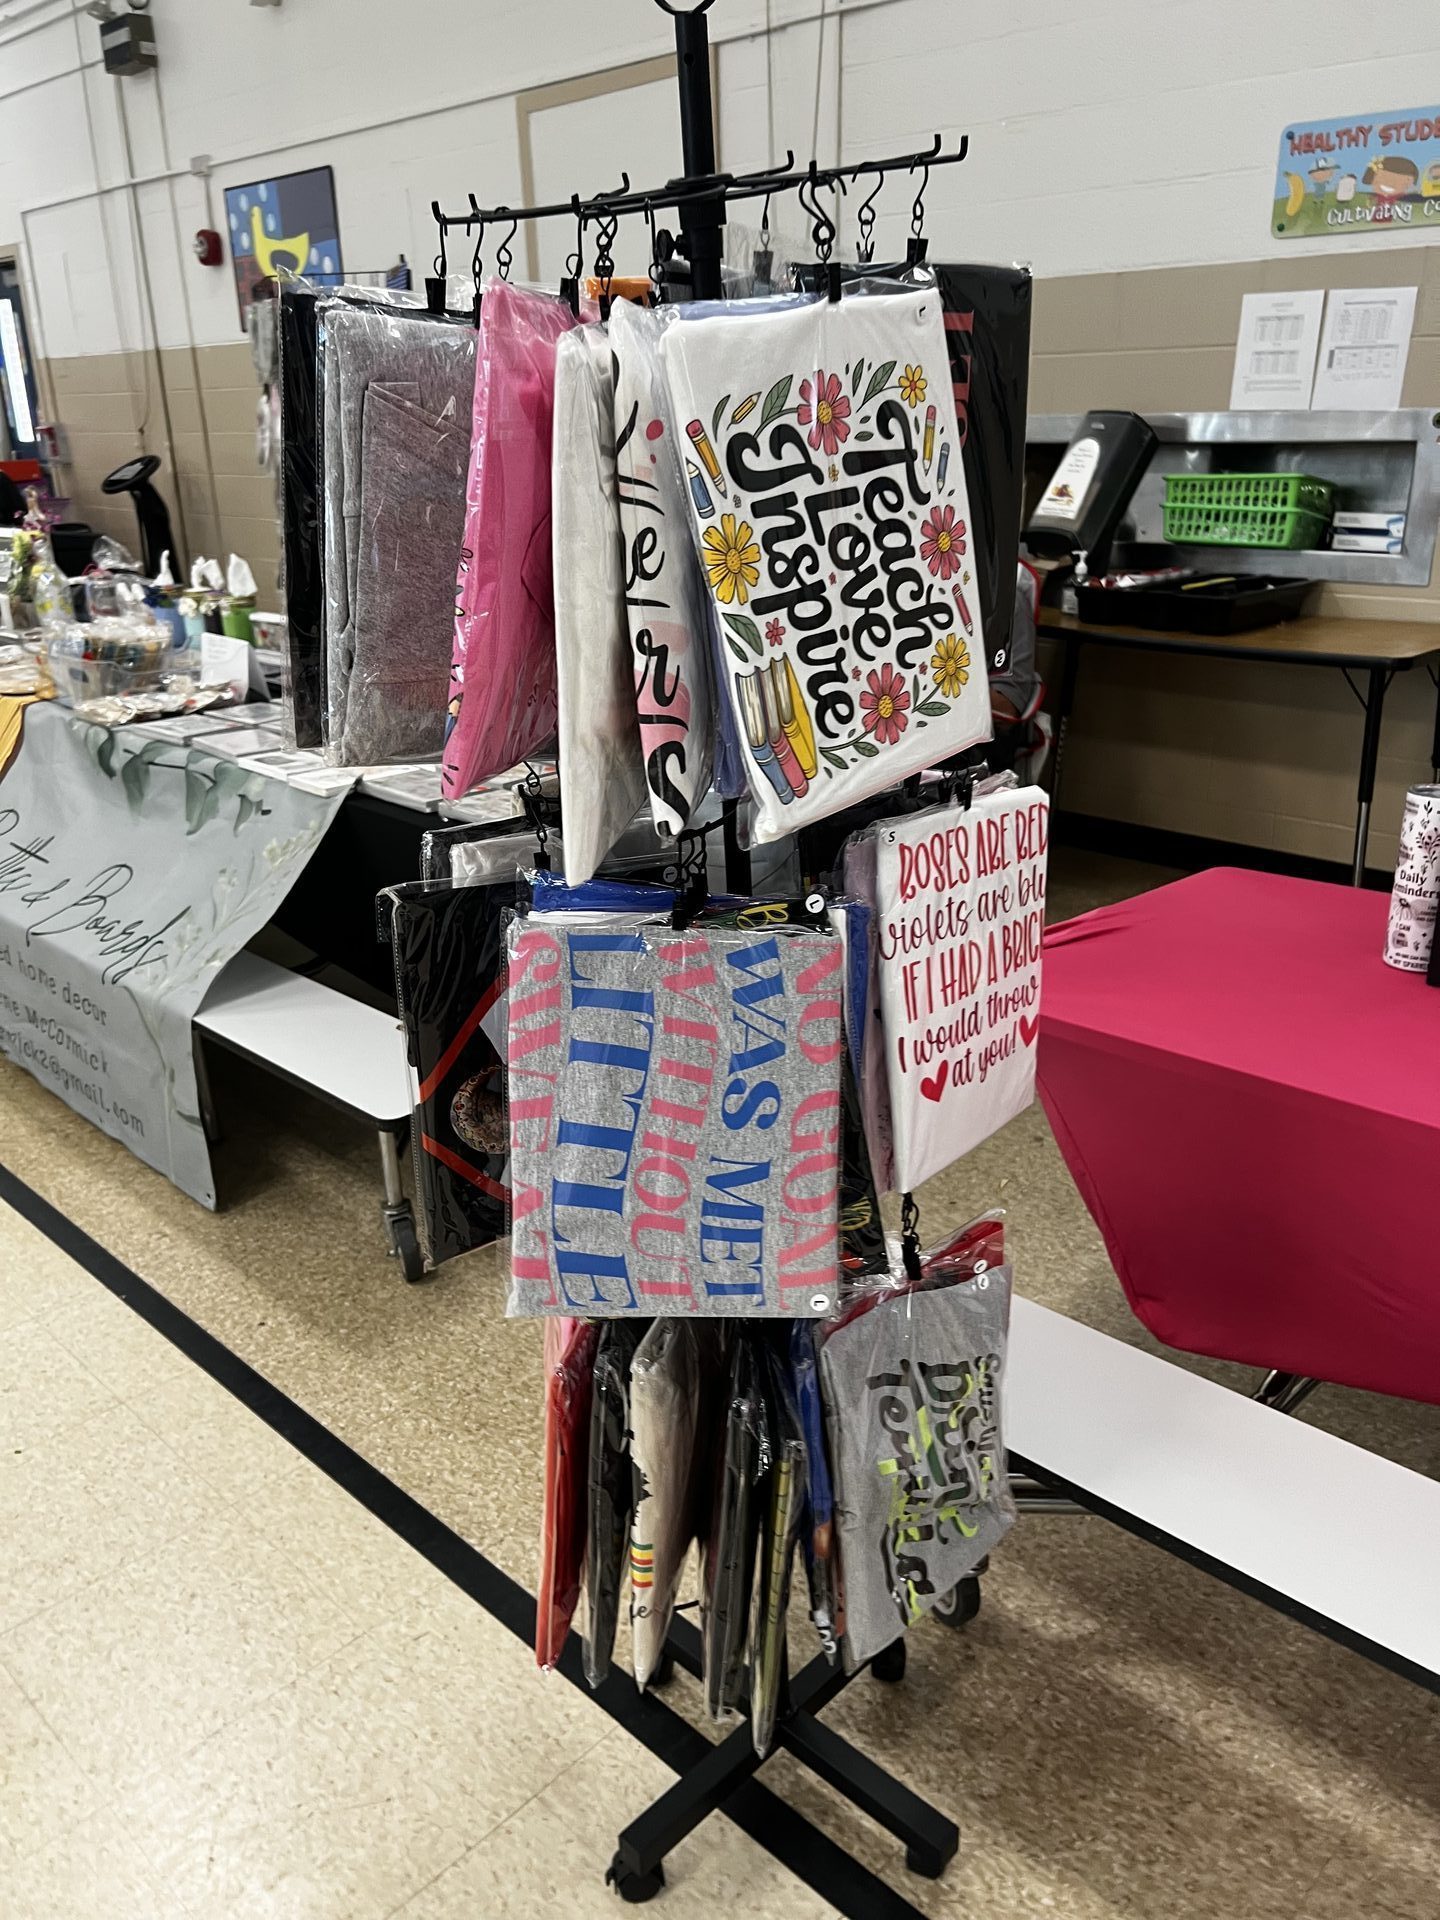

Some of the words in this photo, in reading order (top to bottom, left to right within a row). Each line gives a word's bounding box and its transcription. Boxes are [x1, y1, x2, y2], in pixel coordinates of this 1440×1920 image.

[1290, 125, 1372, 156] HEALTHY
[726, 424, 854, 739] Inspire
[804, 486, 891, 661] Love
[842, 399, 953, 669] Teach
[899, 825, 970, 904] ROSES
[976, 812, 1011, 878] ARE
[1015, 802, 1048, 864] RED
[1400, 869, 1427, 886] Daily
[26, 863, 192, 986] Boards
[878, 896, 974, 960] violets
[978, 885, 1014, 922] are
[902, 960, 921, 1024] IF
[925, 956, 934, 1014] I
[940, 940, 982, 1008] HAD
[987, 930, 998, 986] A
[18, 949, 58, 996] home
[62, 981, 108, 1027] decor
[721, 936, 787, 1131] WAS
[897, 1036, 908, 1073] I
[914, 1001, 983, 1066] would
[986, 974, 1039, 1028] throw
[952, 1048, 975, 1088] at
[978, 1020, 1018, 1083] you!
[552, 931, 655, 1309] LITTLE
[631, 934, 719, 1312] WITHOUT
[700, 1155, 772, 1308] MET
